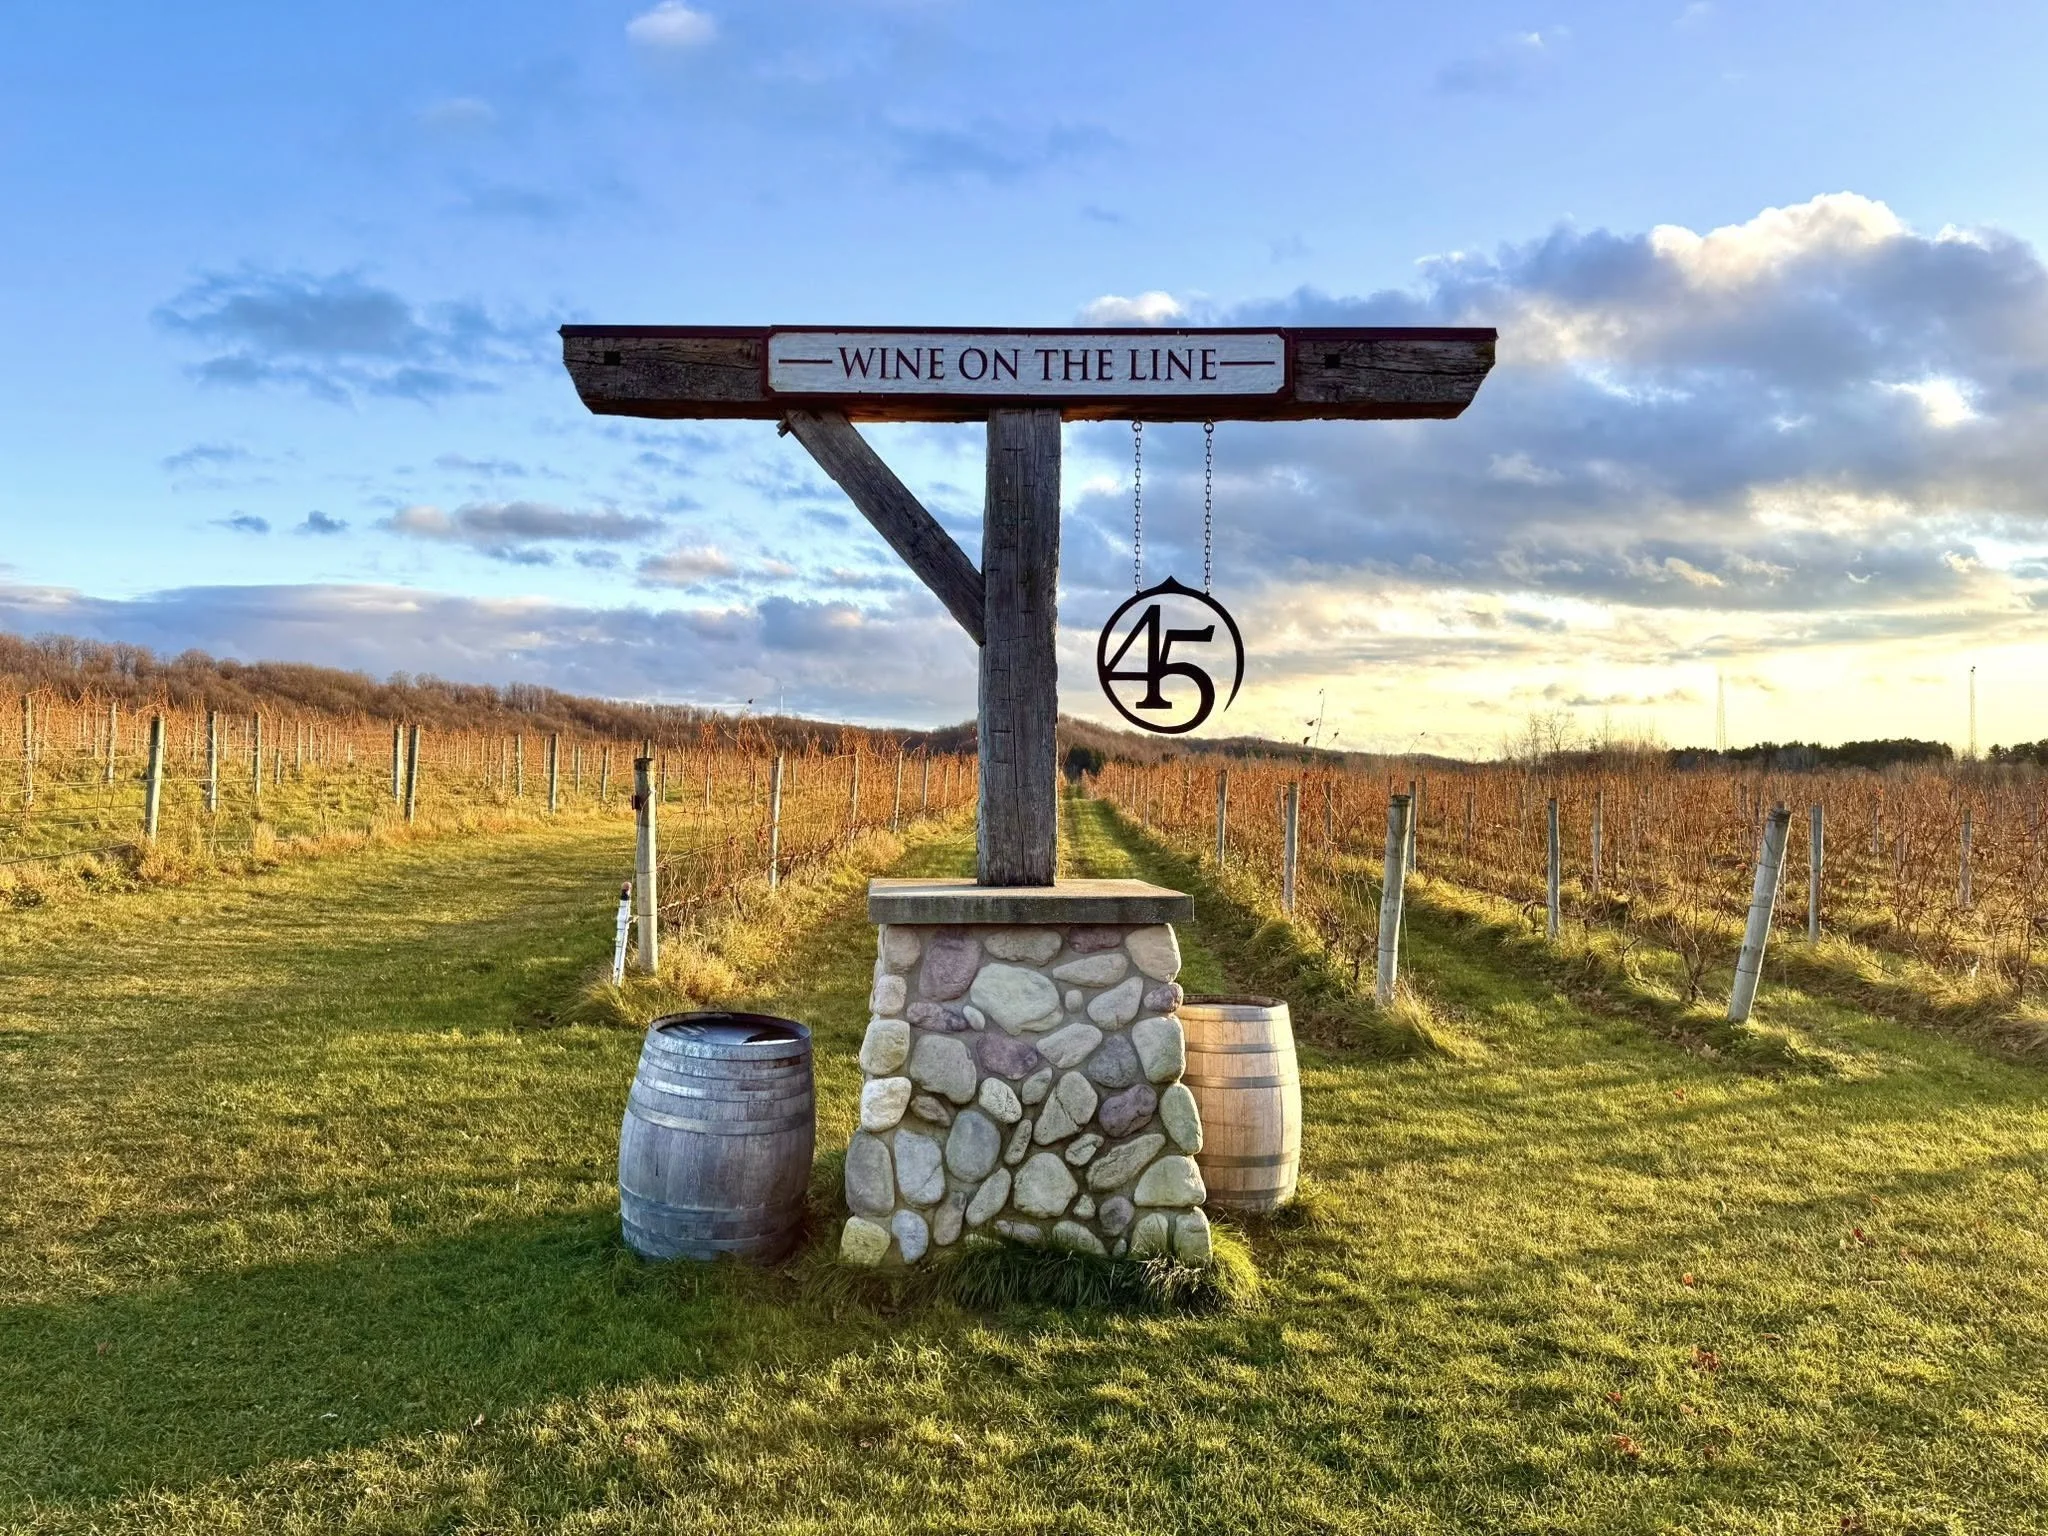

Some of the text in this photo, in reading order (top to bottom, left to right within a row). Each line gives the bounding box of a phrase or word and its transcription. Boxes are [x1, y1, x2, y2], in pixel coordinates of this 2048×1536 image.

[837, 346, 1218, 383] WINE ON THE LINE
[1102, 604, 1217, 735] 45
